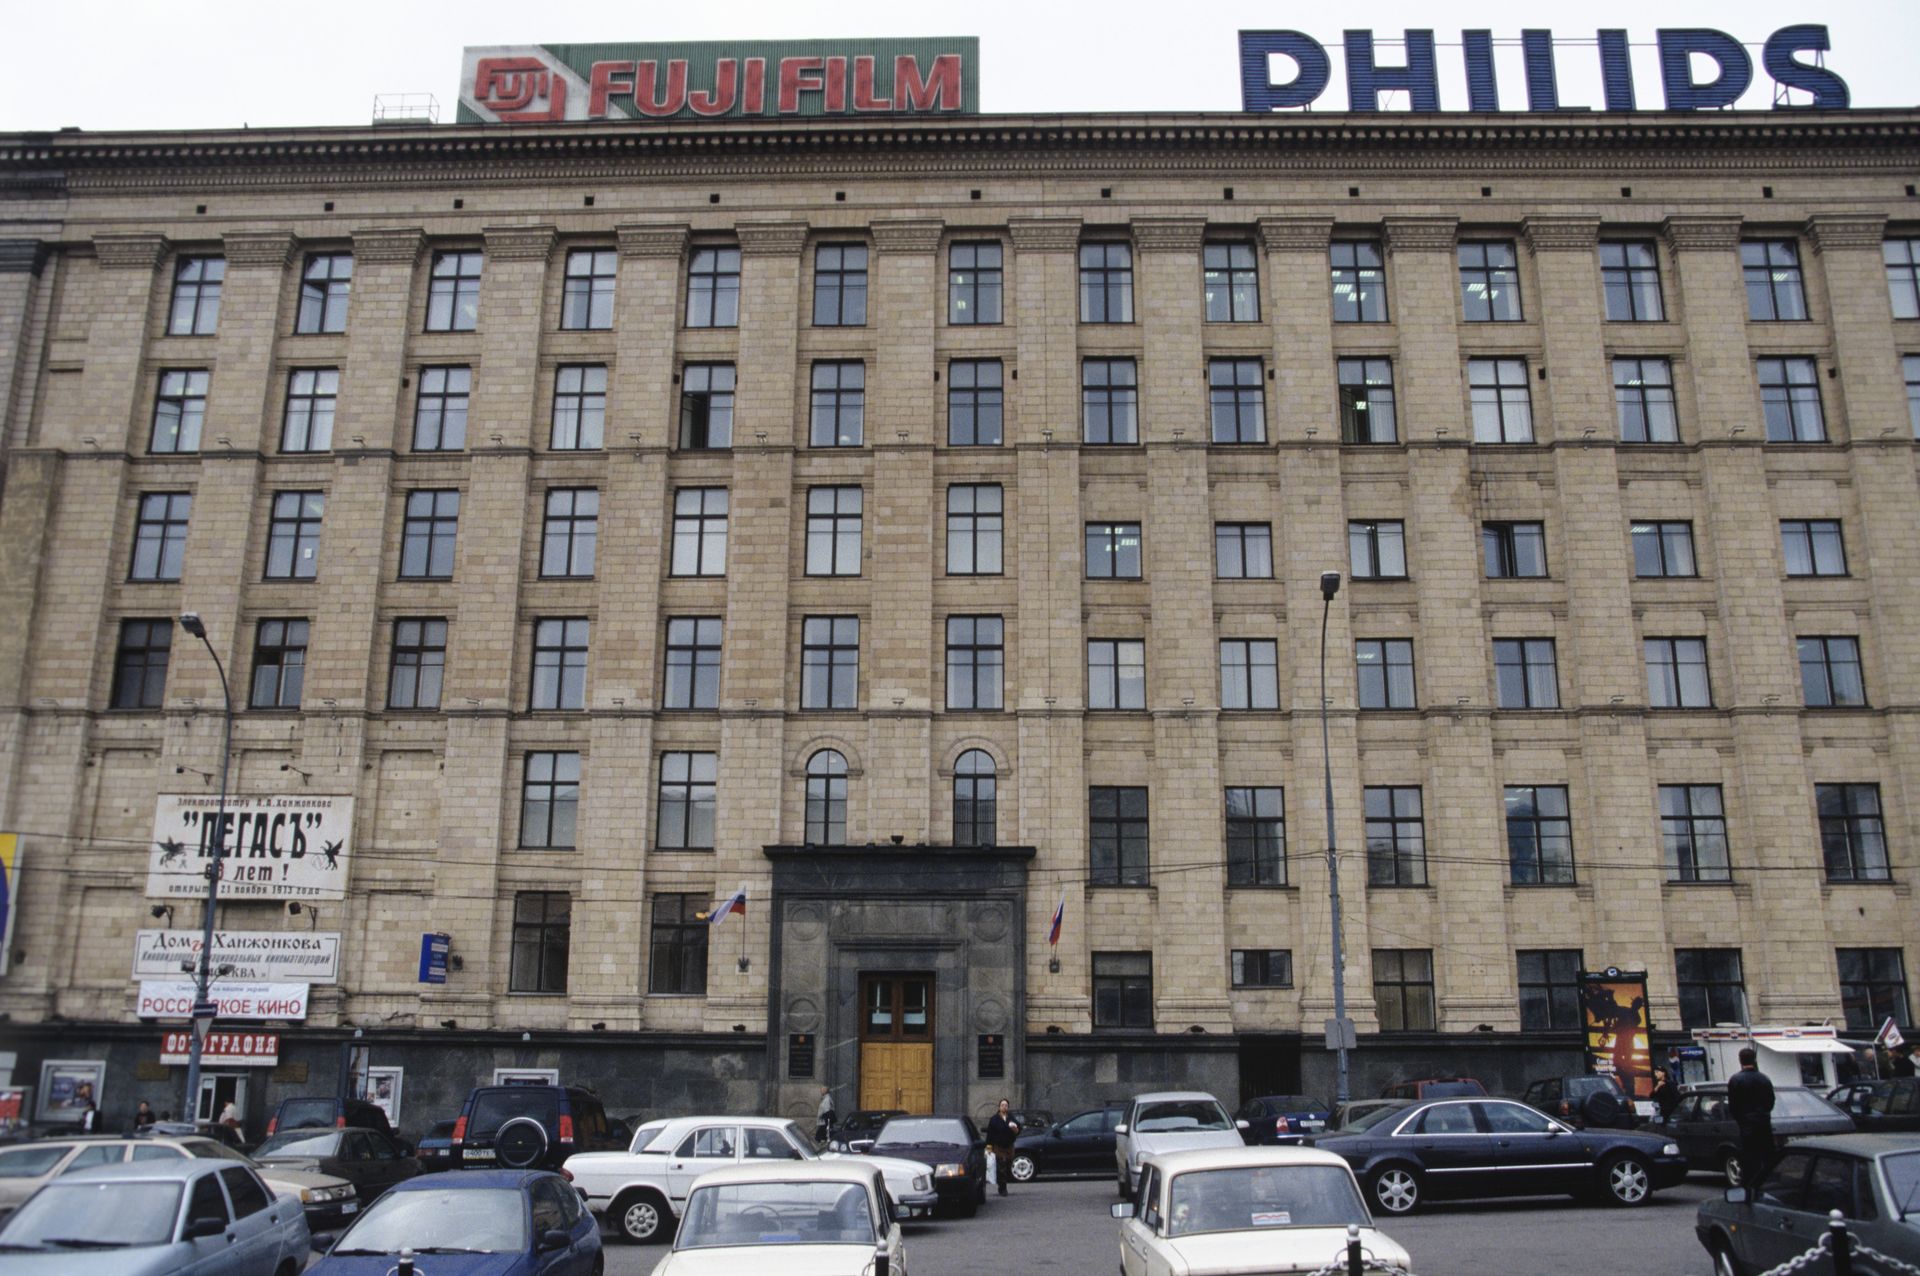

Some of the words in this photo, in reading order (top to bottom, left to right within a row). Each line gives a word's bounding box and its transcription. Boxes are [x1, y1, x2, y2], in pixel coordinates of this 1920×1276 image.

[1238, 24, 1851, 112] PHILIPS
[475, 57, 567, 122] FUJI
[233, 865, 273, 881] лет
[234, 885, 268, 895] ноября
[211, 933, 322, 950] Ханжонкова
[257, 1000, 302, 1015] КИНО
[167, 1034, 277, 1054] ФОГРАФИЯ
